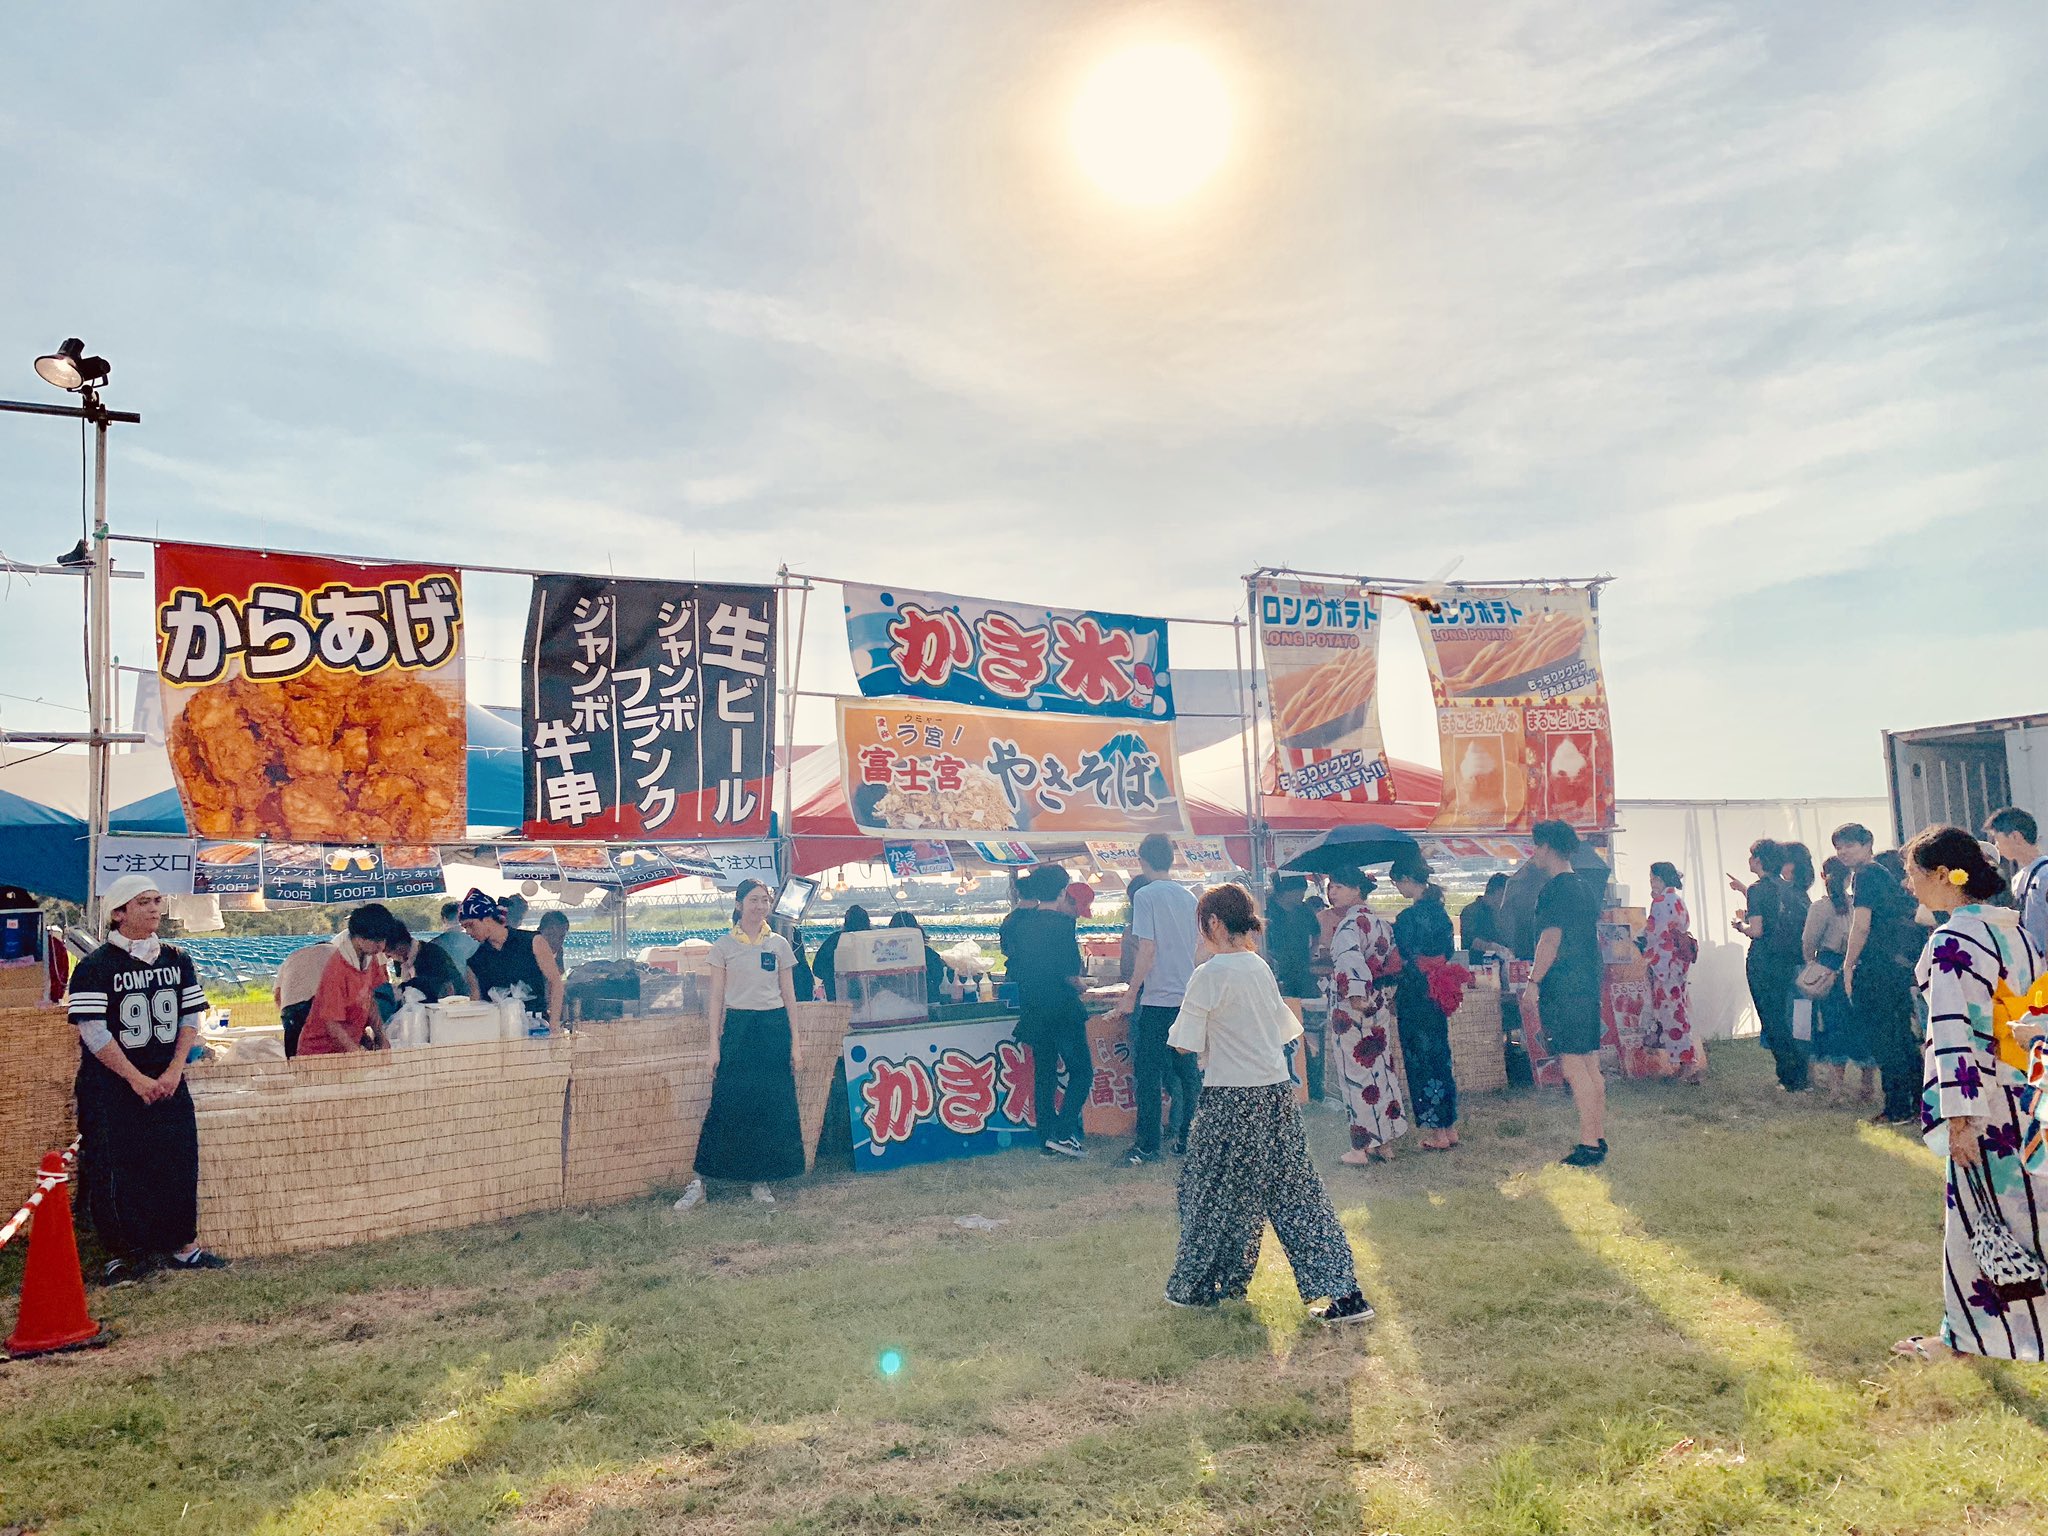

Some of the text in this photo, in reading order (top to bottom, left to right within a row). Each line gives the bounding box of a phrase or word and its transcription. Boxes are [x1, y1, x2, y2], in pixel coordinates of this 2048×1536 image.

[1263, 596, 1378, 630] ロングポテト
[161, 578, 459, 684] からあげ
[1263, 630, 1360, 649] LONG POTATO
[1431, 629, 1513, 642] LONG POTATO
[571, 597, 611, 732] ジャンボ
[658, 600, 697, 732] ジャンボ
[890, 604, 1136, 704] かき氷
[702, 602, 769, 823] 生ビール
[612, 668, 677, 830] フランク
[534, 720, 602, 825] 牛串
[858, 739, 1159, 813] 富士宮 やきそば
[102, 853, 191, 872] ご注文口
[384, 868, 441, 881] からあげ
[630, 869, 667, 884] 500円
[324, 872, 383, 884] 生ビール
[333, 886, 376, 899] 500円
[396, 882, 434, 894] 500円
[276, 889, 311, 900] 700円
[113, 966, 181, 993] COMPTON
[119, 988, 178, 1049] 99
